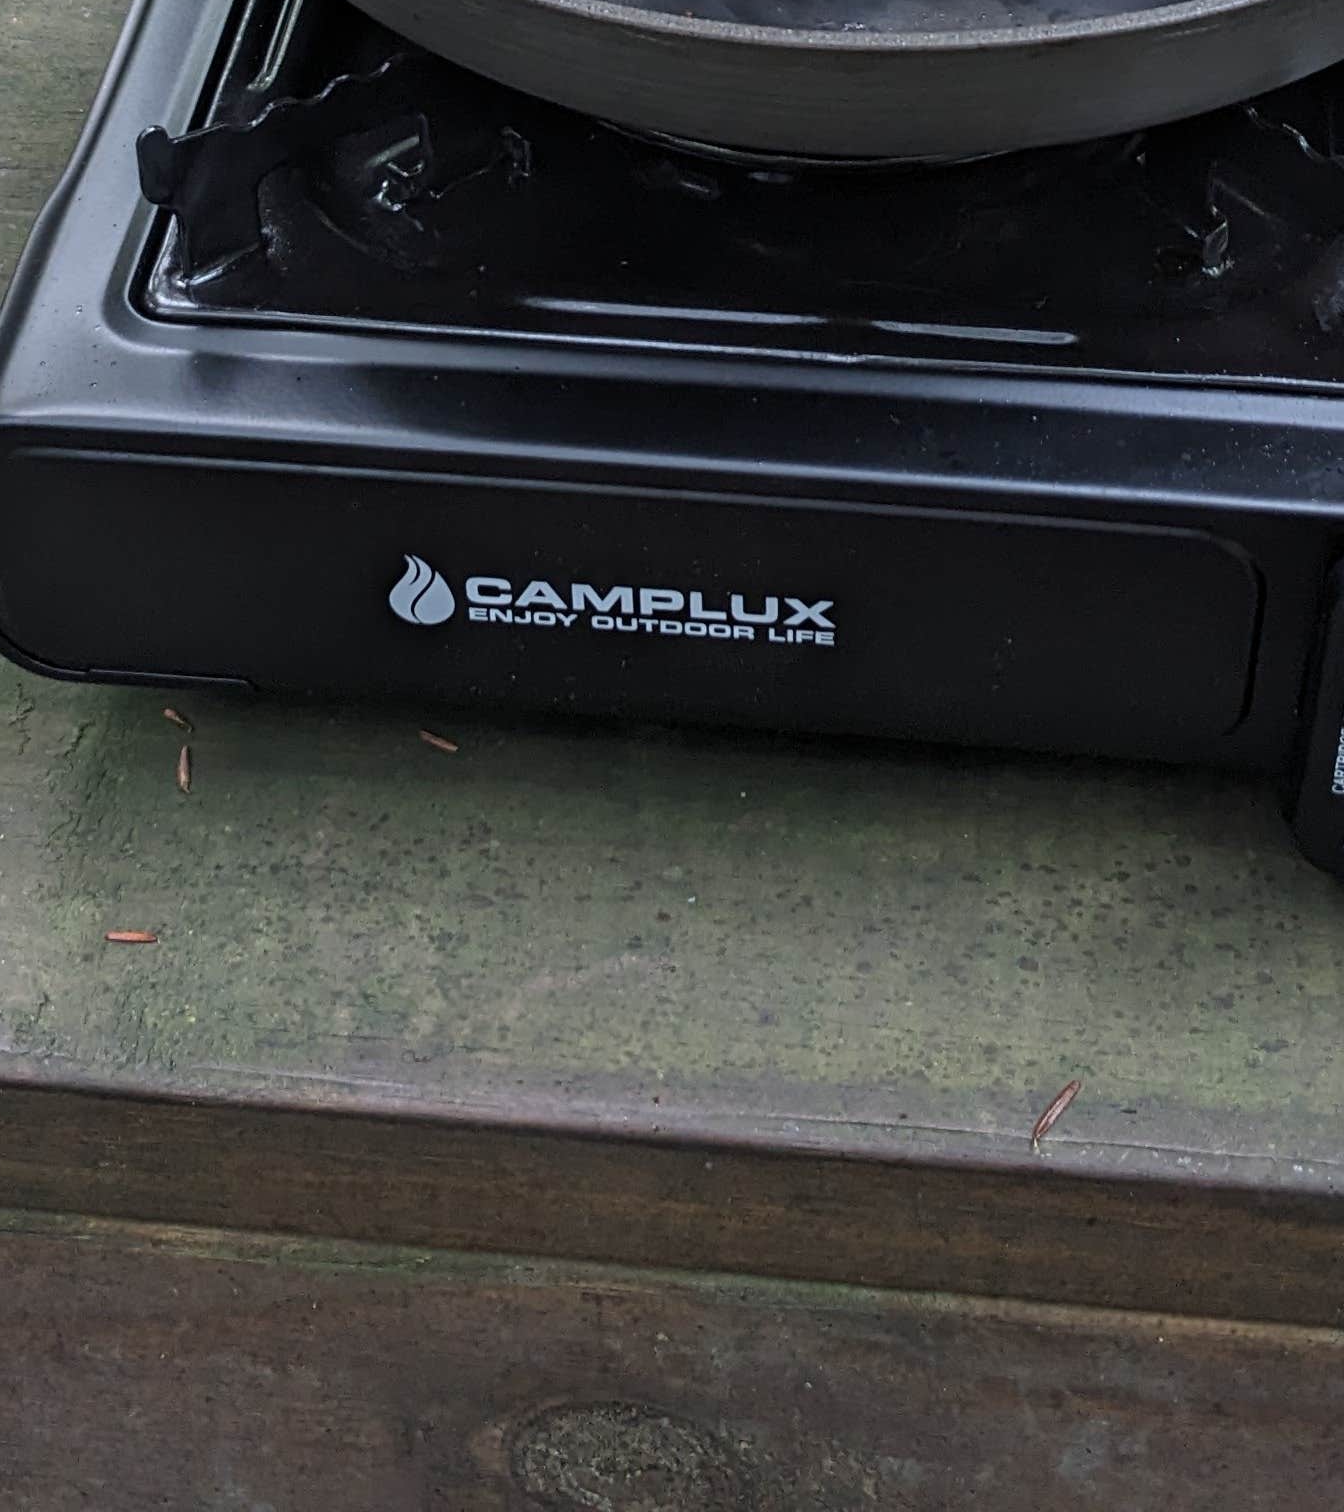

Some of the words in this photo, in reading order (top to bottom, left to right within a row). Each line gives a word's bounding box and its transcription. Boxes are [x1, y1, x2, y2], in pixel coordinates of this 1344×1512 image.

[465, 576, 836, 629] CAMPLUX
[468, 606, 578, 628] ENJOY
[591, 614, 755, 641] OUTDOOR
[767, 628, 836, 646] LIFE
